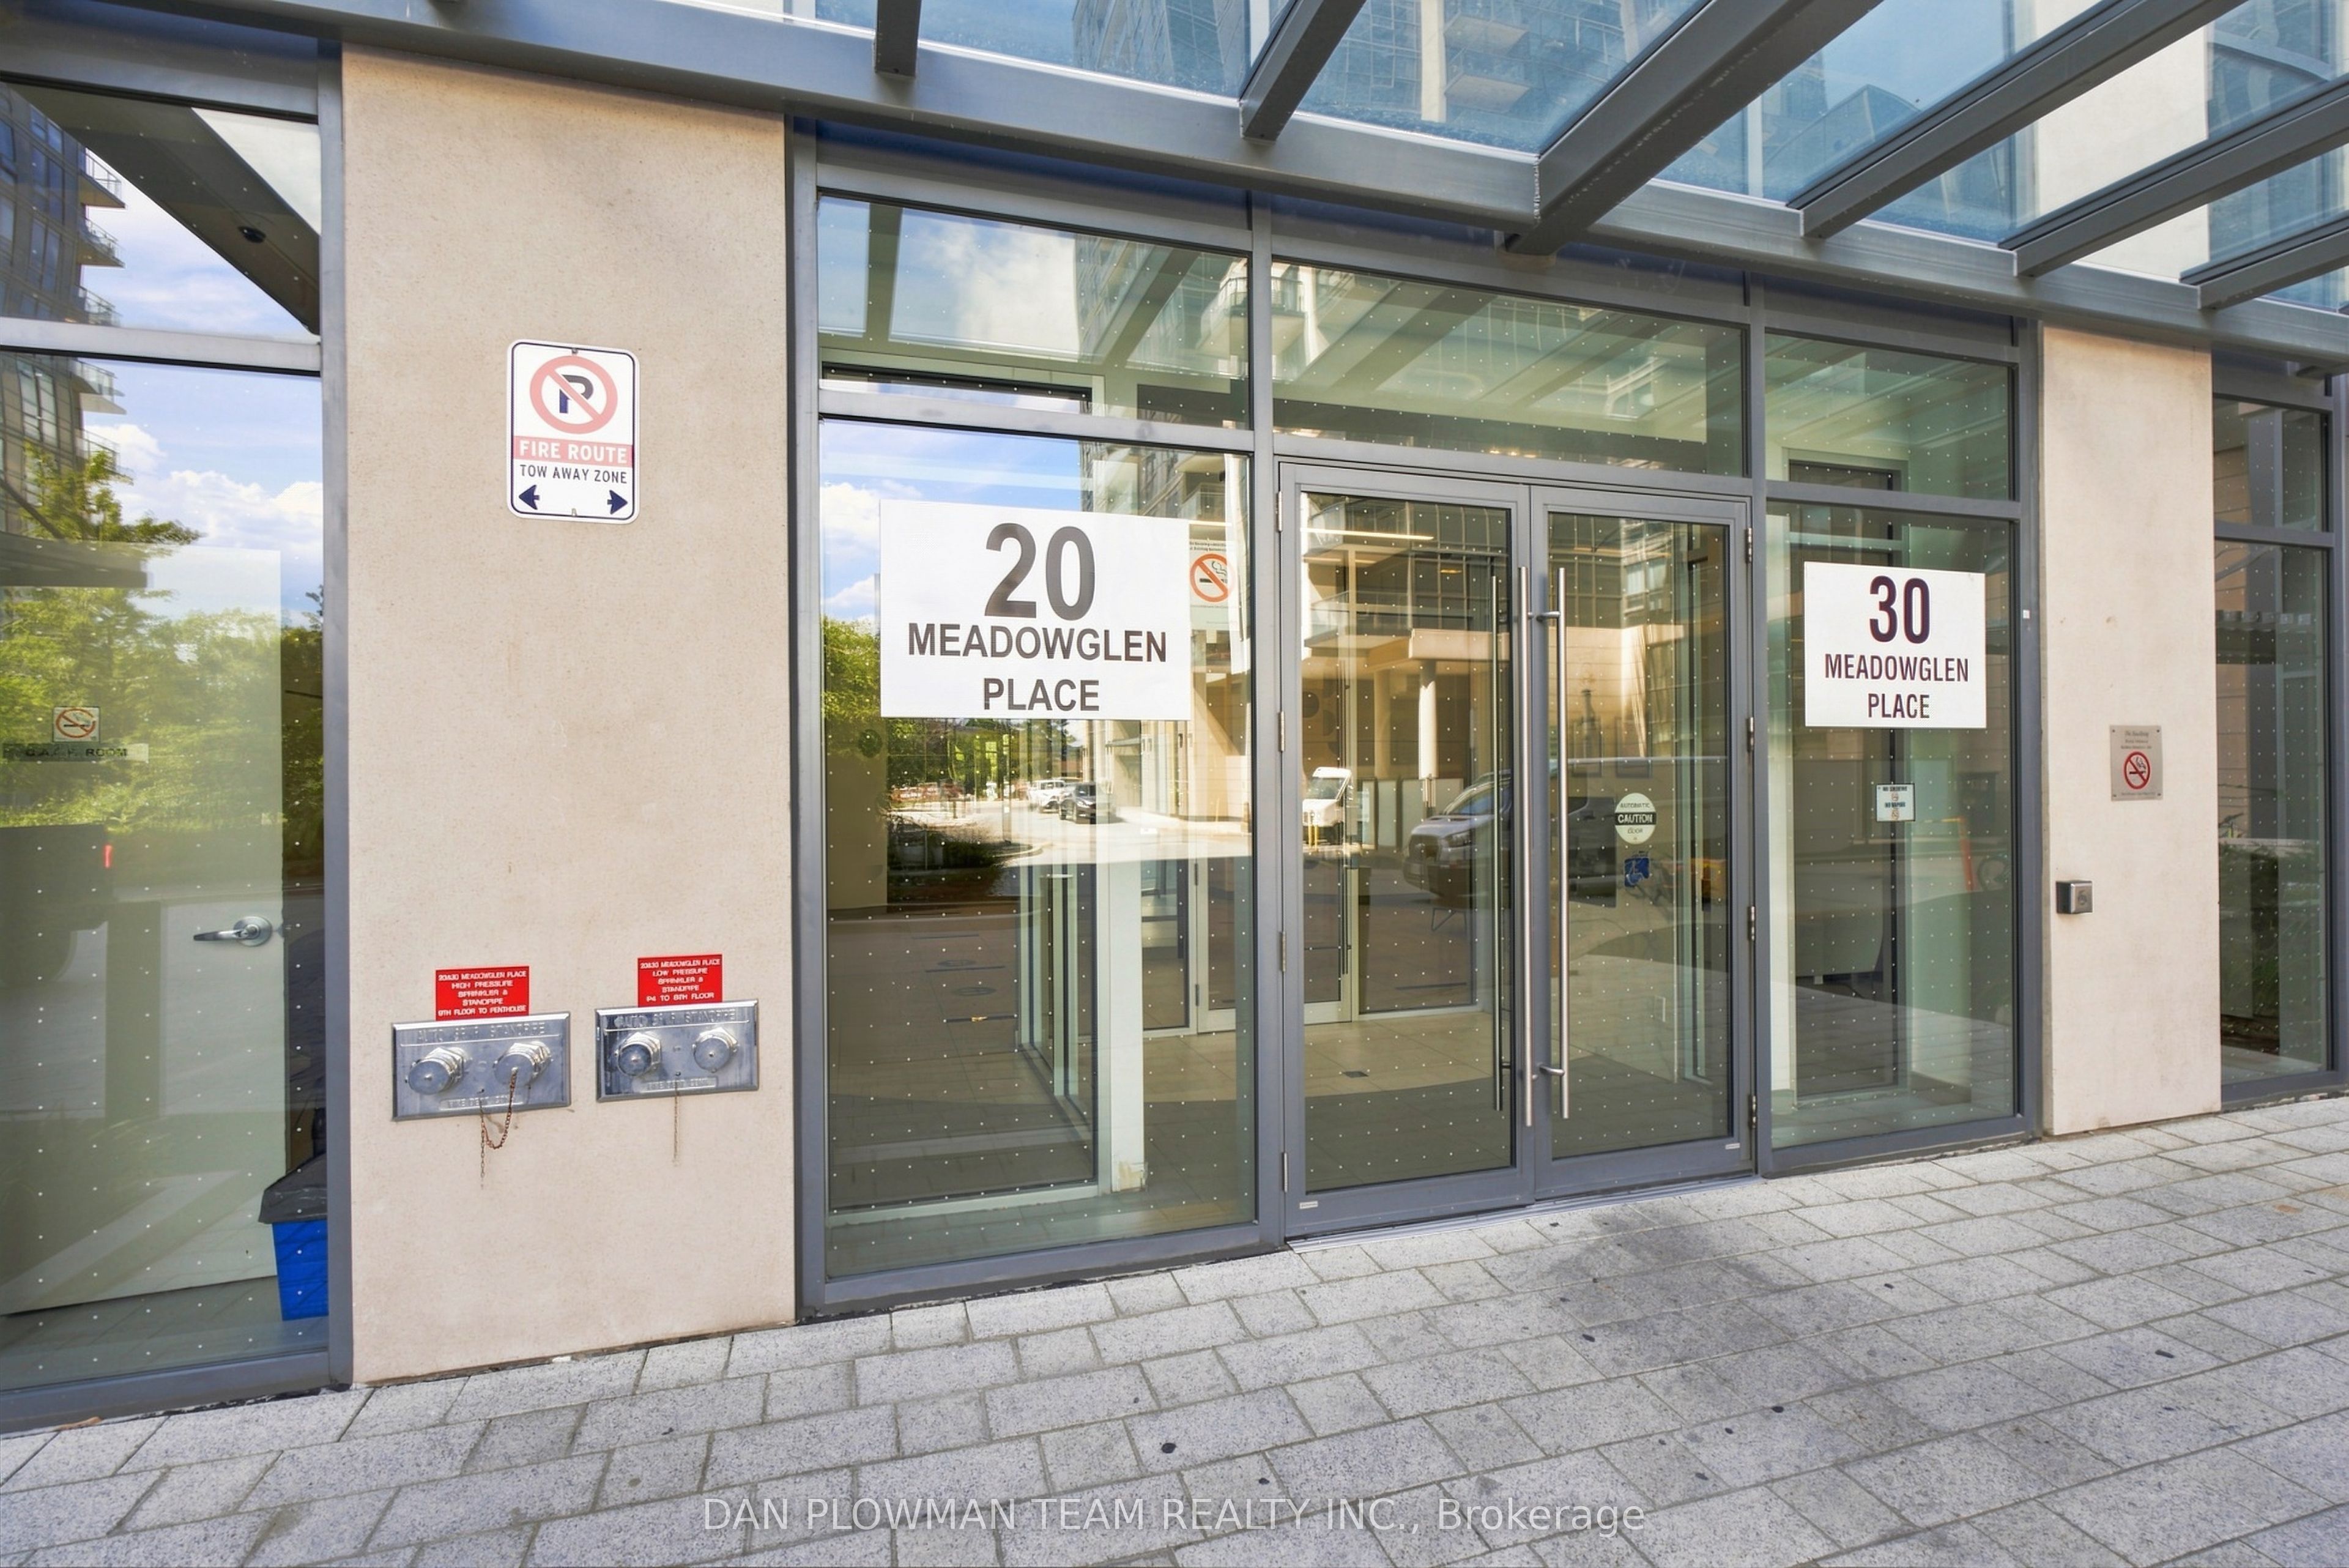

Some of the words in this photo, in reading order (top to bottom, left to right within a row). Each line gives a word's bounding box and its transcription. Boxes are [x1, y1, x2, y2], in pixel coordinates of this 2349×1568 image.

[520, 440, 561, 459] FIRE
[568, 444, 627, 464] ROUTE
[521, 464, 547, 478] TOW
[552, 467, 589, 481] AWAY
[595, 470, 627, 484] ZONE
[984, 522, 1095, 620] 20
[1869, 575, 1930, 644] 30
[908, 623, 1166, 662] MEADOWGLEN
[1825, 653, 1969, 682] MEADOWGLEN
[984, 678, 1099, 711] PLACE
[1868, 693, 1930, 719] PLACE
[1618, 814, 1653, 823] CAUTION
[461, 972, 505, 980] MEADOWGLEN
[658, 976, 696, 985] SPRINKLER
[458, 989, 499, 998] SPRINKLER
[462, 998, 503, 1006] STANDPIPE
